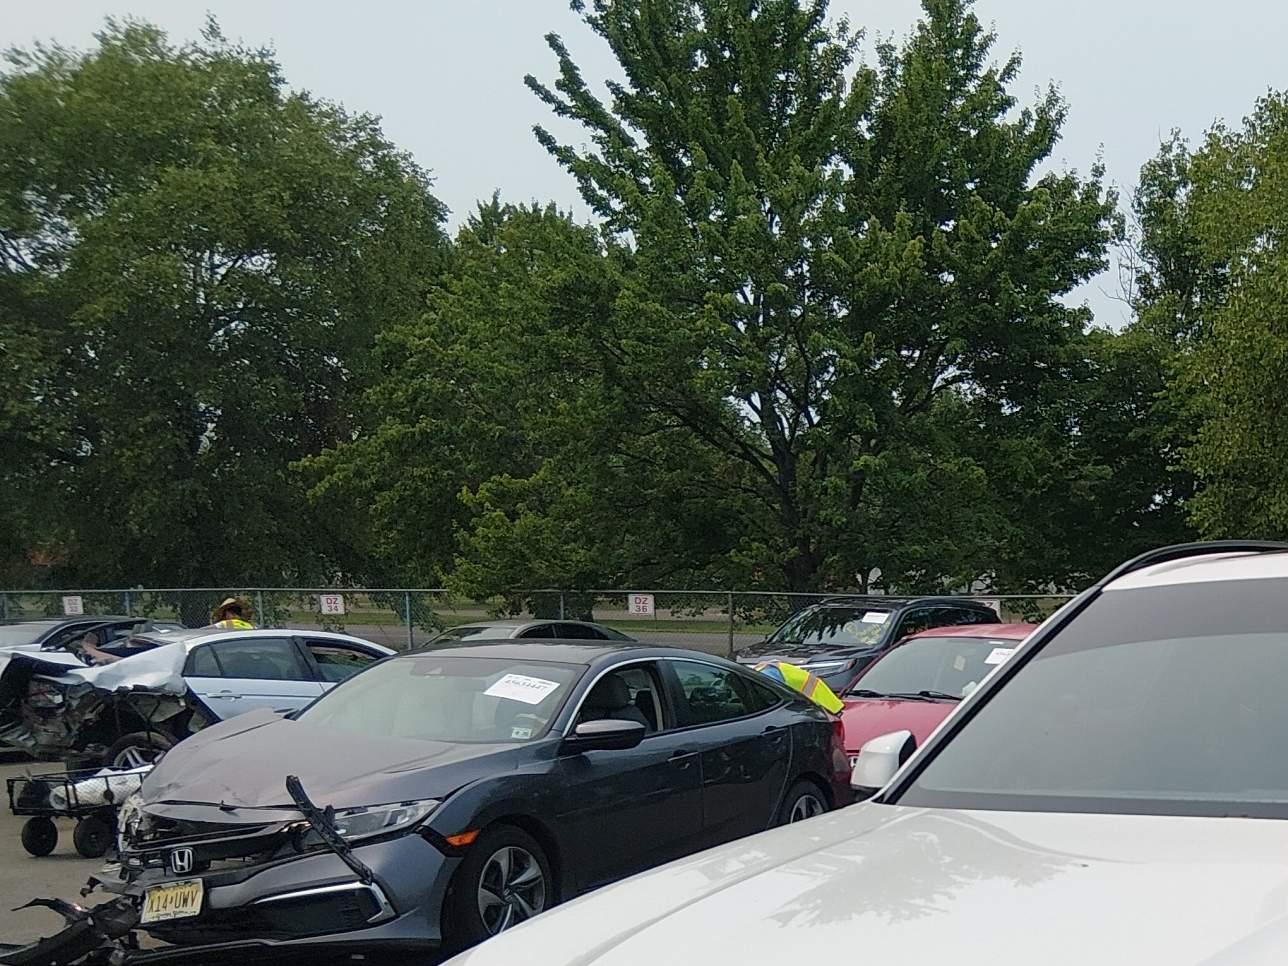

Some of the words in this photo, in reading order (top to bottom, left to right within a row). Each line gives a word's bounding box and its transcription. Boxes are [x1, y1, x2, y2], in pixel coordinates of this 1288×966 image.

[326, 597, 339, 605] DZ
[634, 596, 649, 605] DZ
[635, 605, 648, 613] 36
